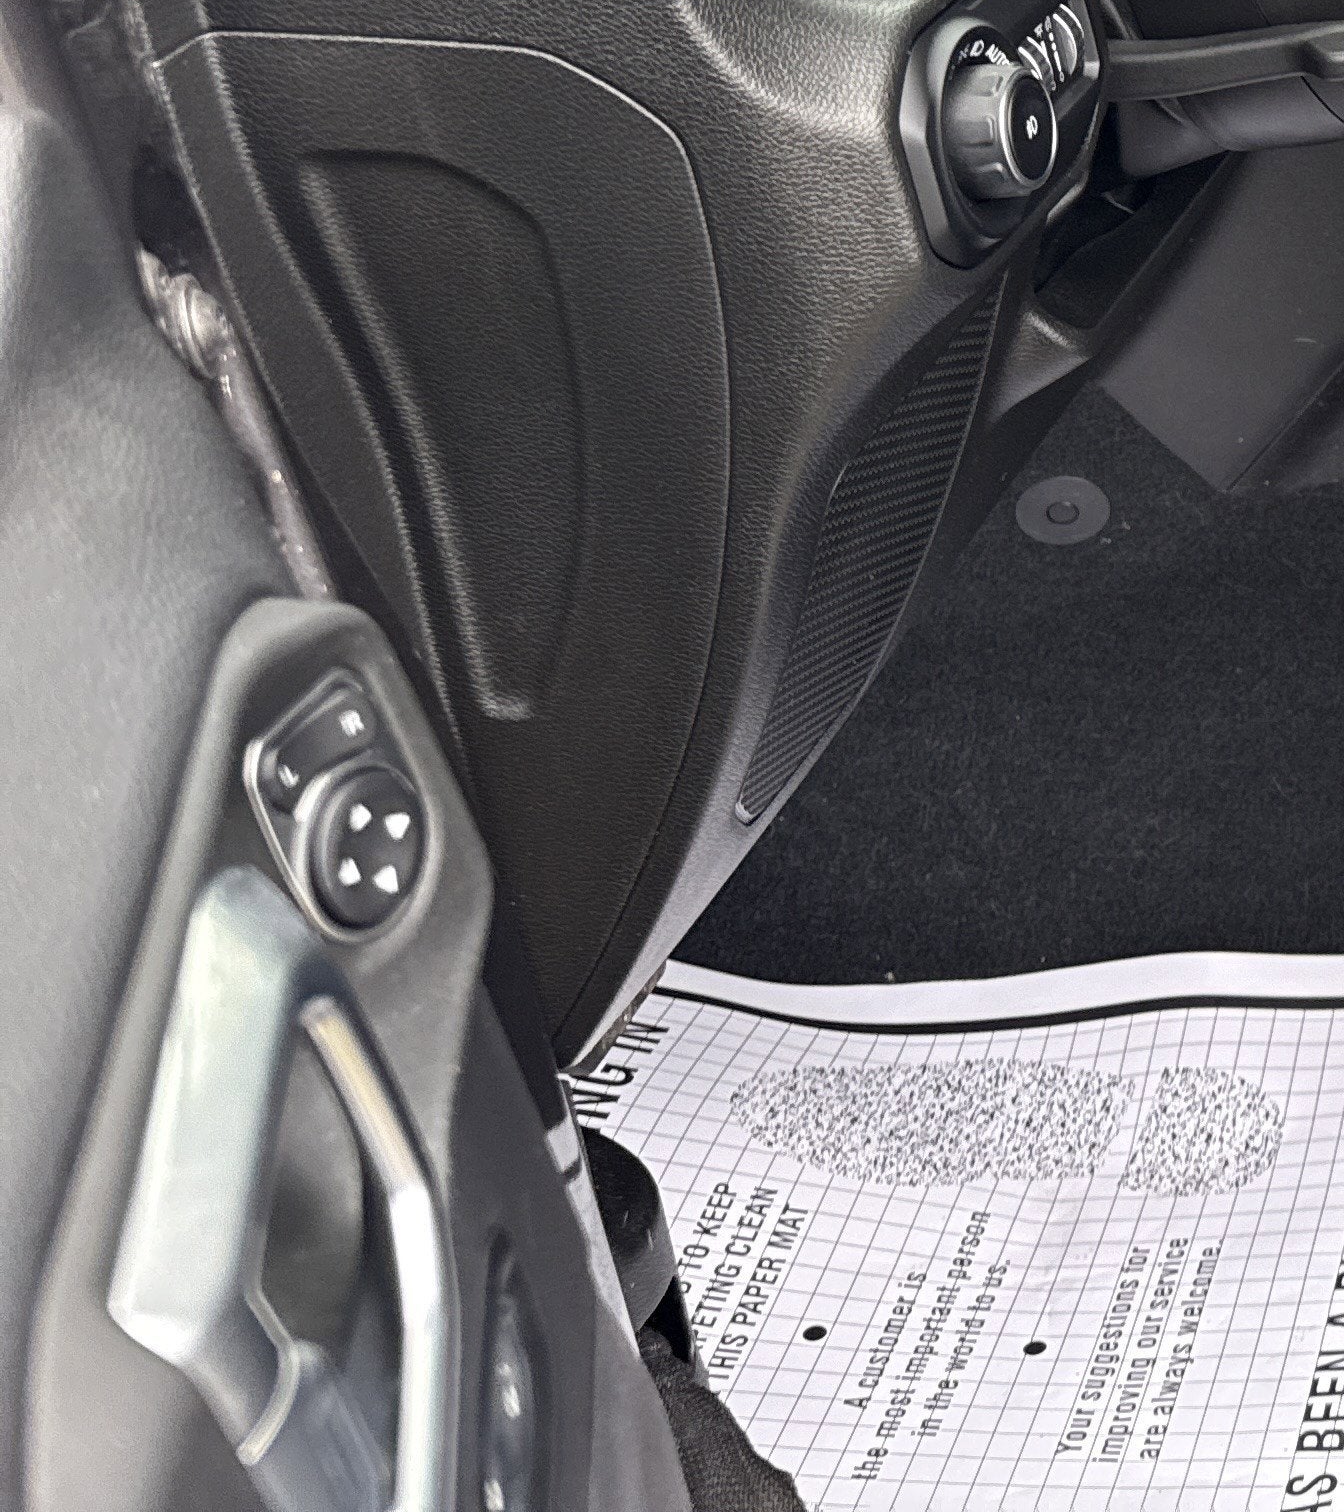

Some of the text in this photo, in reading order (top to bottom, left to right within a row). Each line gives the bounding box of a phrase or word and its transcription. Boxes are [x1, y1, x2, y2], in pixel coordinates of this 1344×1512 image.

[615, 1021, 670, 1054] IN
[677, 1182, 737, 1269] TO KEEP
[725, 1186, 778, 1257] CLEAN
[731, 1256, 787, 1327] PAPER
[767, 1202, 808, 1250] MAT
[843, 1271, 927, 1409] A customer is
[851, 1210, 991, 1480] the most important person
[911, 1259, 1011, 1437] in the world to us.
[1055, 1246, 1150, 1455] Your suggestions for
[1091, 1237, 1188, 1463] improving our service
[1139, 1238, 1224, 1460] are always welcome.
